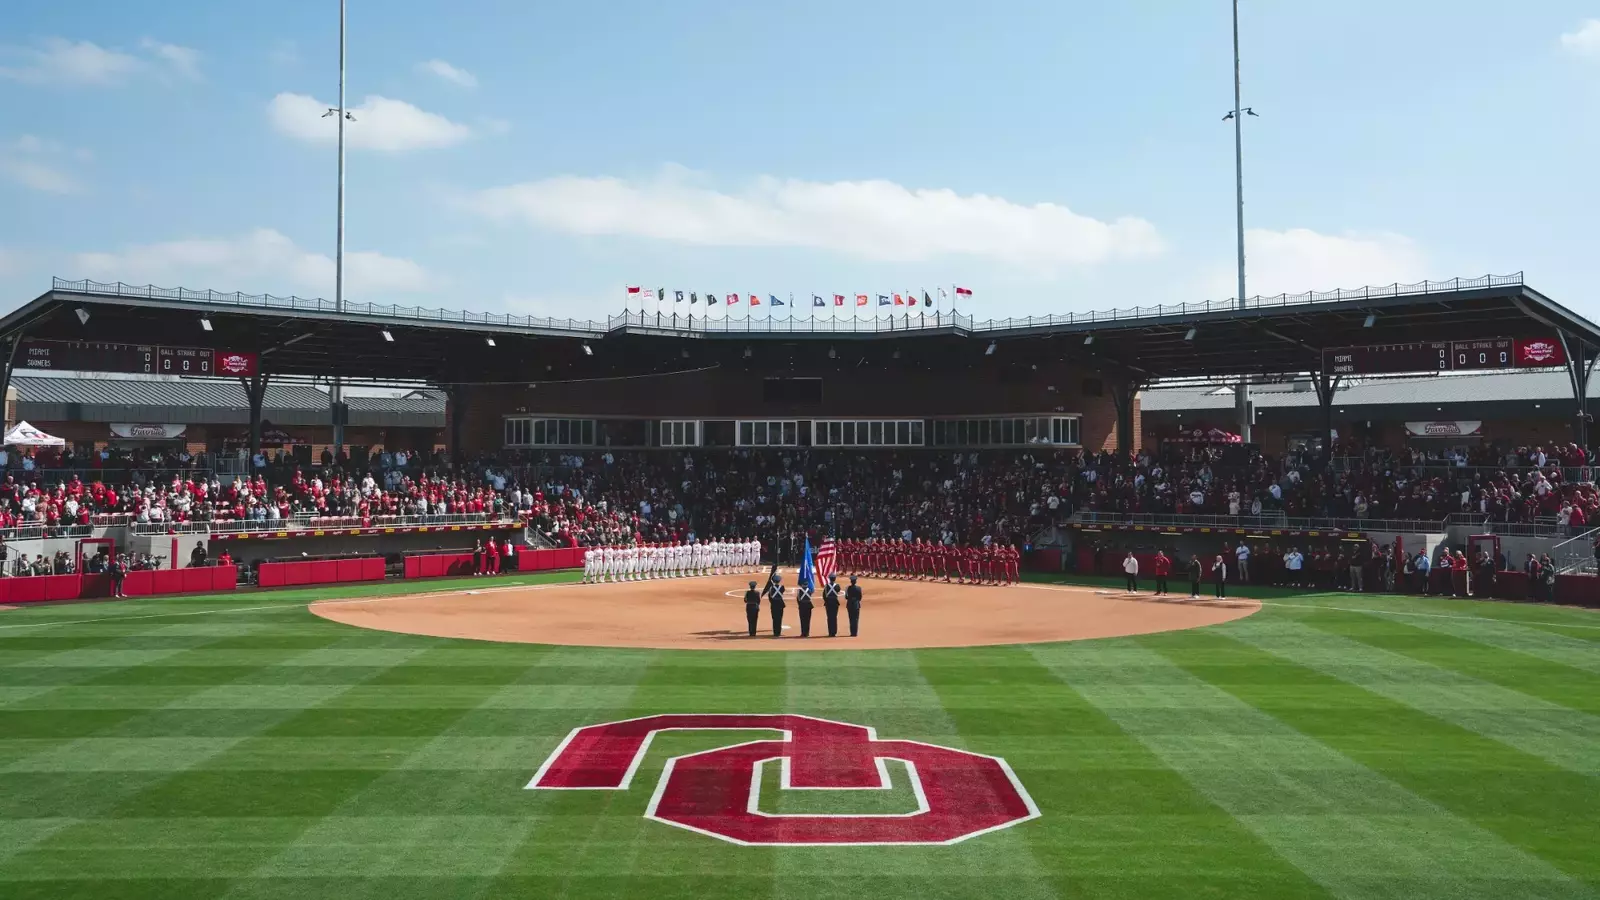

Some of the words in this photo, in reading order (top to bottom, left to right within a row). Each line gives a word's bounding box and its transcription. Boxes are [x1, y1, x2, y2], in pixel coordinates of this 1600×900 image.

[29, 348, 50, 356] MIAMI
[177, 349, 196, 357] STRIKE
[1439, 349, 1445, 358] 0
[144, 353, 150, 361] 0
[1460, 353, 1466, 364] 0
[1479, 353, 1486, 364] 0
[1500, 352, 1507, 362] 0
[144, 364, 150, 372] 0
[164, 359, 171, 369] 0
[183, 360, 190, 370] 0
[201, 361, 208, 371] 0
[1439, 360, 1445, 368] 0
